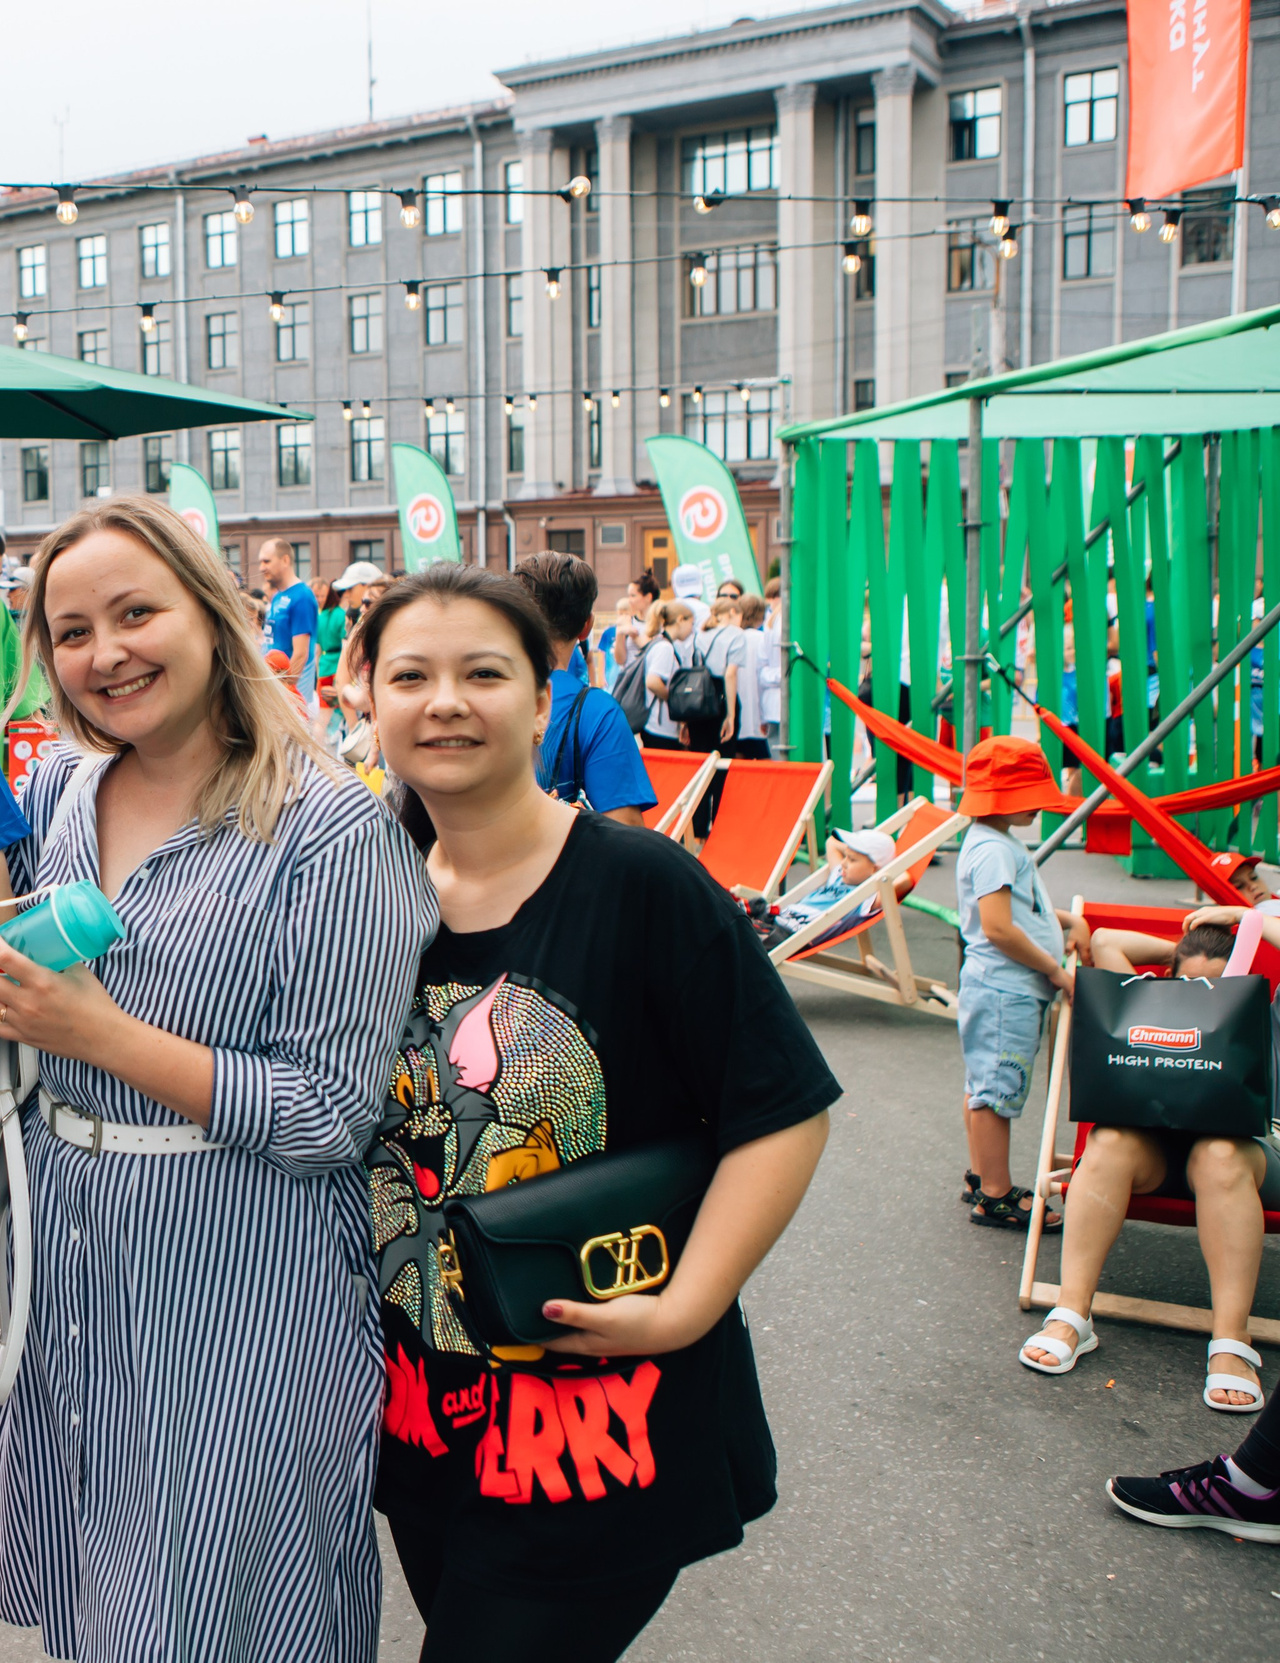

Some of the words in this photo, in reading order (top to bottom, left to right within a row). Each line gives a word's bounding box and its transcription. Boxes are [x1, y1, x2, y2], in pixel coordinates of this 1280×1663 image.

[1131, 1029, 1194, 1044] Ehrmann
[1107, 1054, 1150, 1067] HIGH
[1154, 1056, 1222, 1071] PROTEIN
[442, 1372, 487, 1418] and
